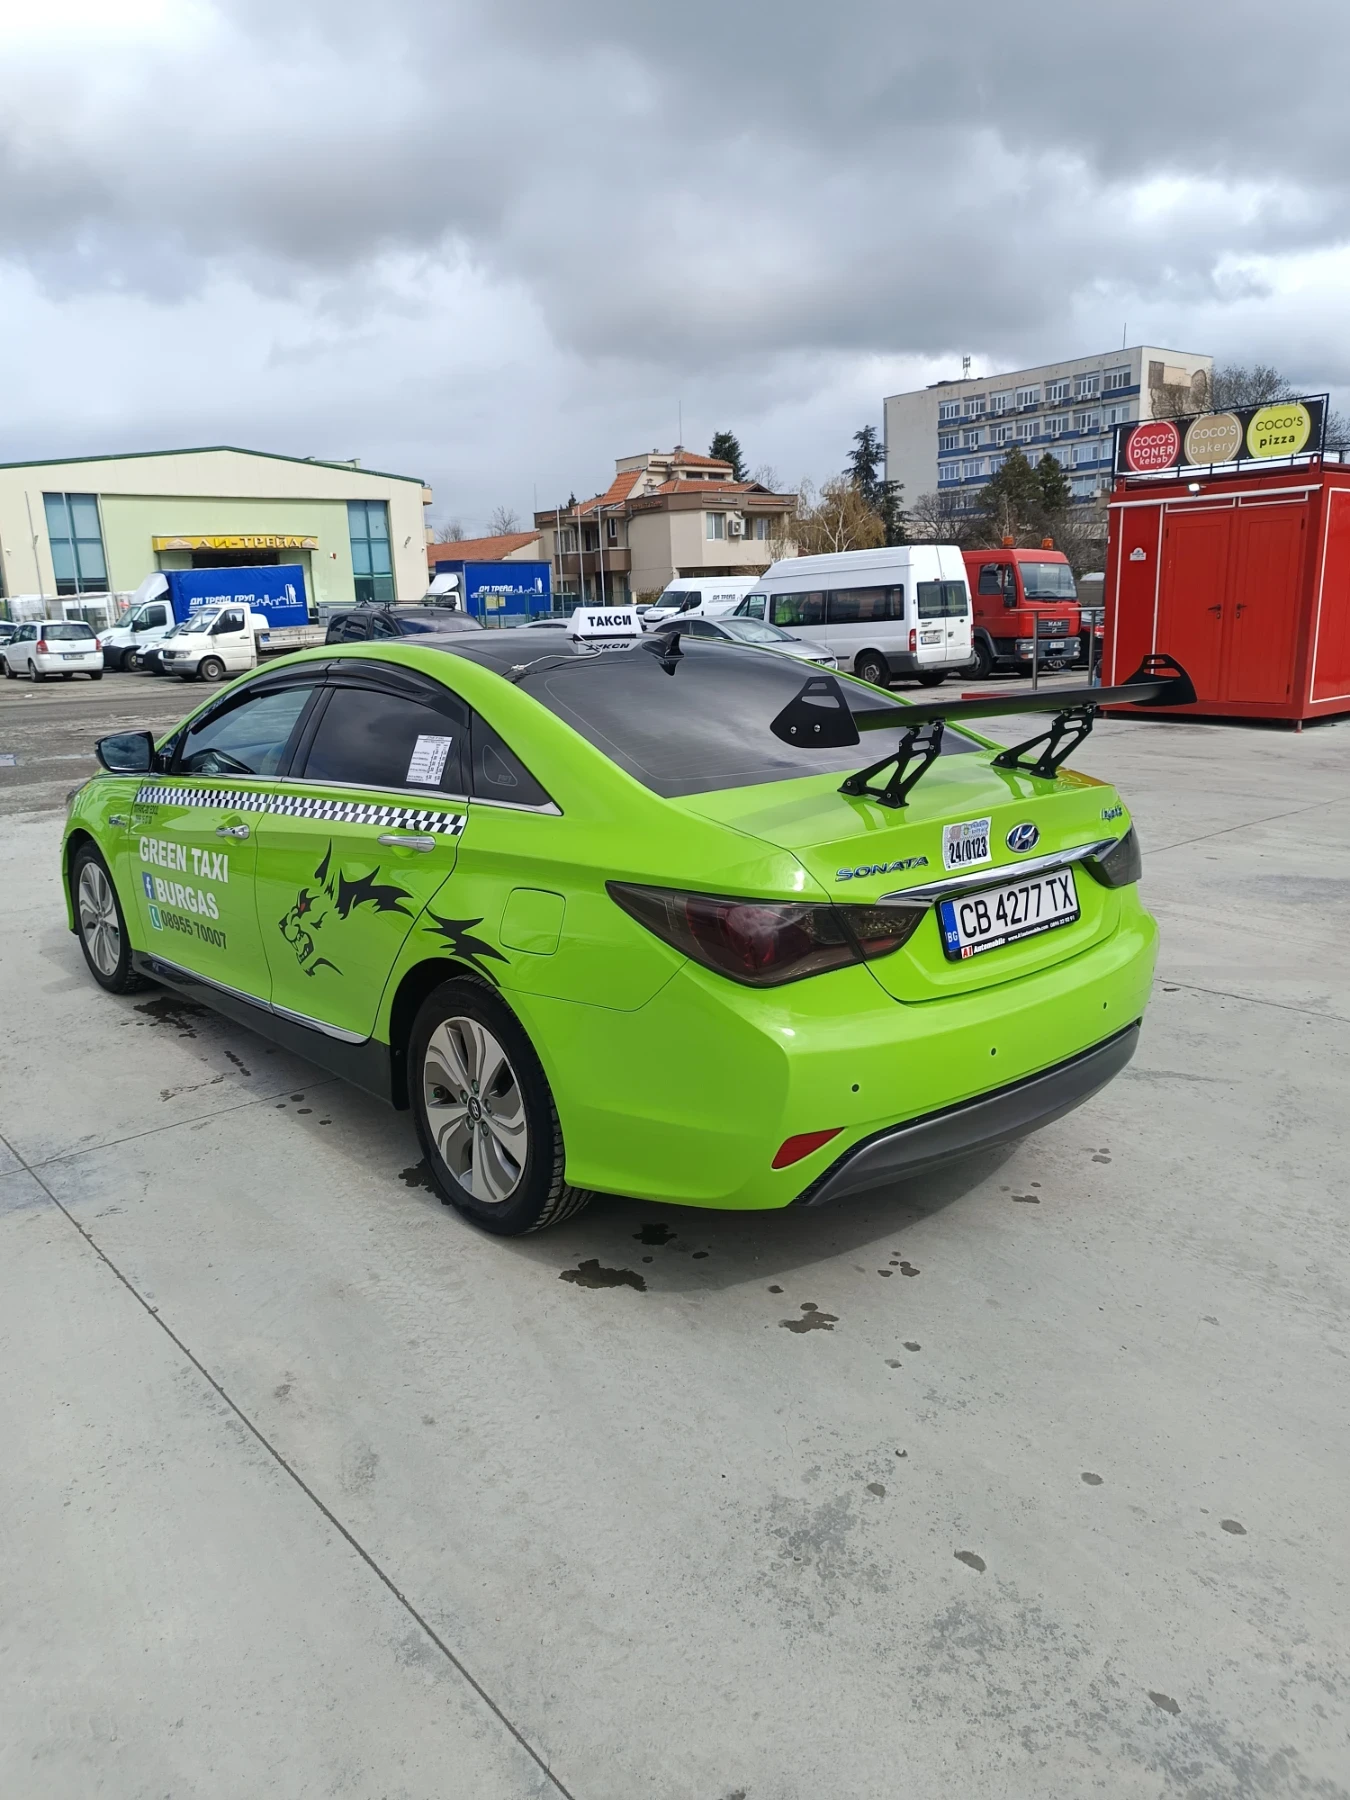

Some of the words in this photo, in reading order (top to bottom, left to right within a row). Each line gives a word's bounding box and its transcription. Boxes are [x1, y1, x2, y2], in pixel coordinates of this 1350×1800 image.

[1255, 416, 1304, 432] COCO'S
[1192, 425, 1237, 440] COCO'S
[1133, 433, 1175, 448] COCO'S
[1191, 441, 1236, 455] bakery
[1259, 434, 1295, 448] pizza
[1133, 445, 1174, 459] DONER
[1139, 453, 1168, 466] kebab
[197, 535, 302, 550] ДИ-ТРЕЙД
[190, 597, 203, 605] ДИ
[205, 595, 231, 604] ТРЕЙД
[234, 594, 255, 602] ГРУП
[587, 615, 632, 627] ТАКСИ
[949, 836, 988, 864] 24/0123
[139, 836, 187, 872] GREEN
[191, 847, 229, 883] TAXI
[835, 856, 929, 882] SONATA
[154, 877, 220, 920] BURGAS
[960, 899, 992, 938] CB
[996, 883, 1042, 927] 4277
[1045, 875, 1074, 911] TX
[161, 909, 194, 936] 08955
[193, 921, 227, 950] 70007
[948, 931, 958, 943] BG
